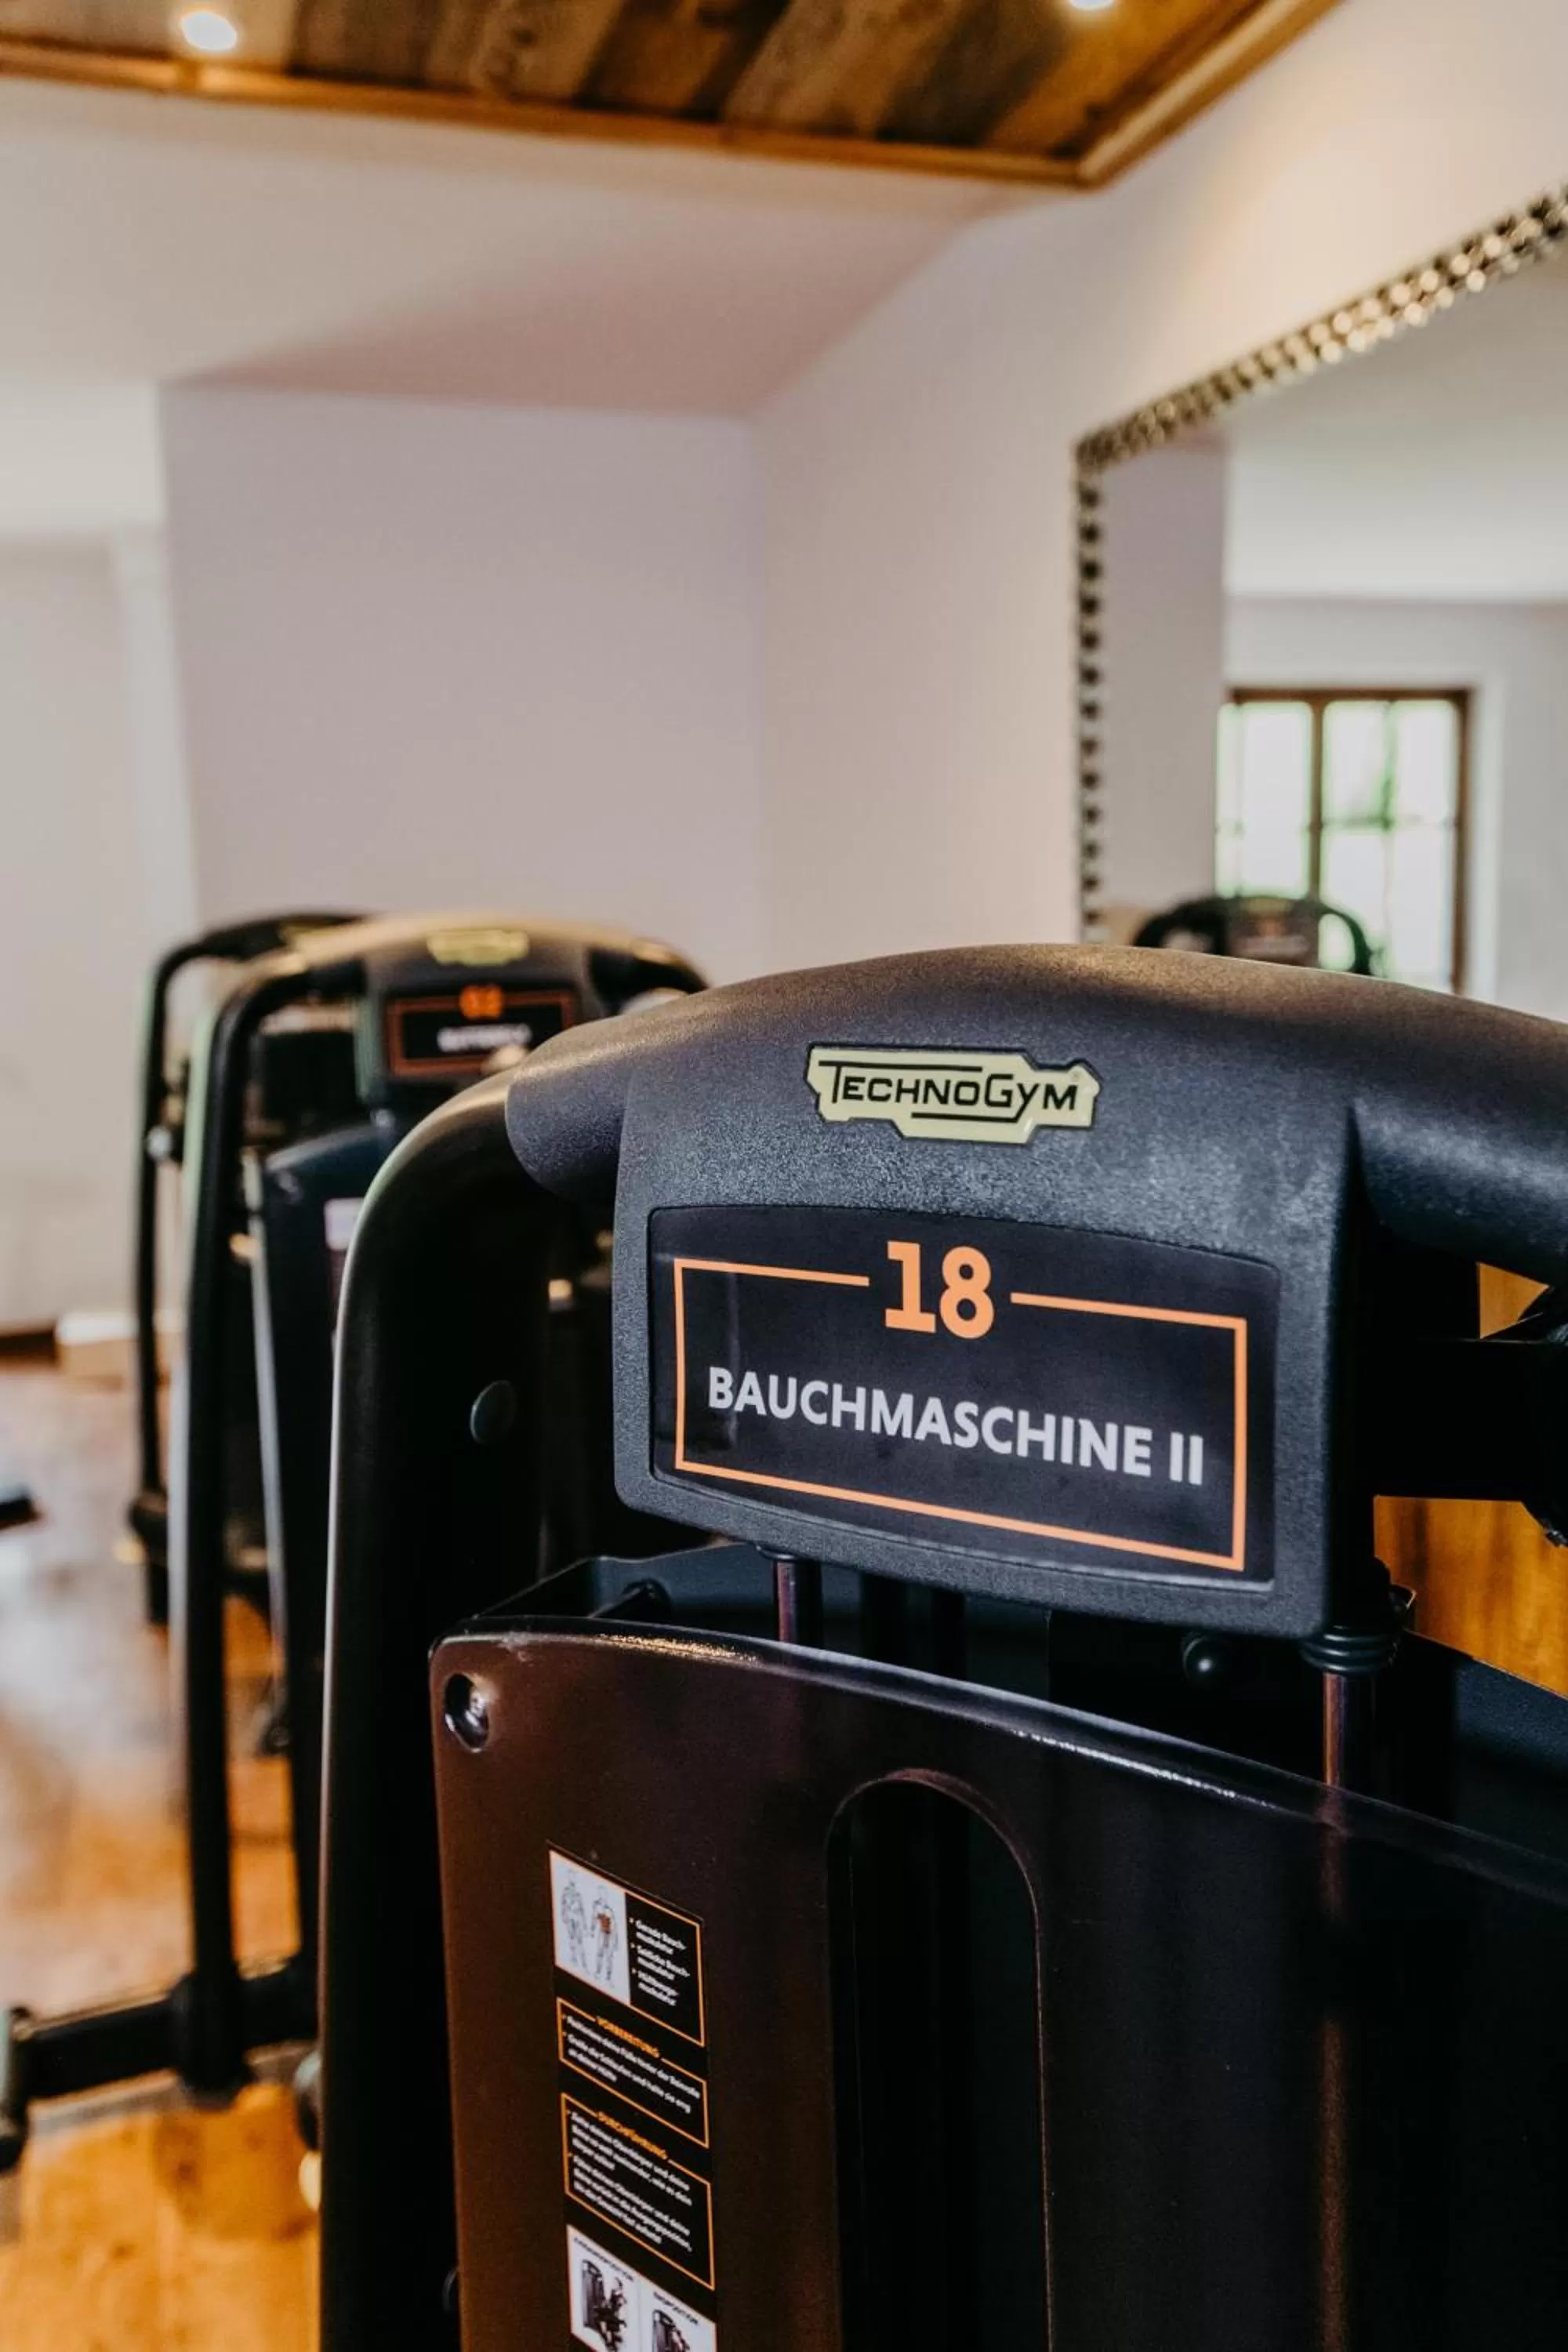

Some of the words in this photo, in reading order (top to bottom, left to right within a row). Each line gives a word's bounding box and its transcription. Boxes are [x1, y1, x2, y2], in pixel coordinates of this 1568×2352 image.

[885, 1240, 996, 1340] 18
[708, 1367, 1152, 1477] BAUCHMASCHINE
[1169, 1432, 1204, 1486] II
